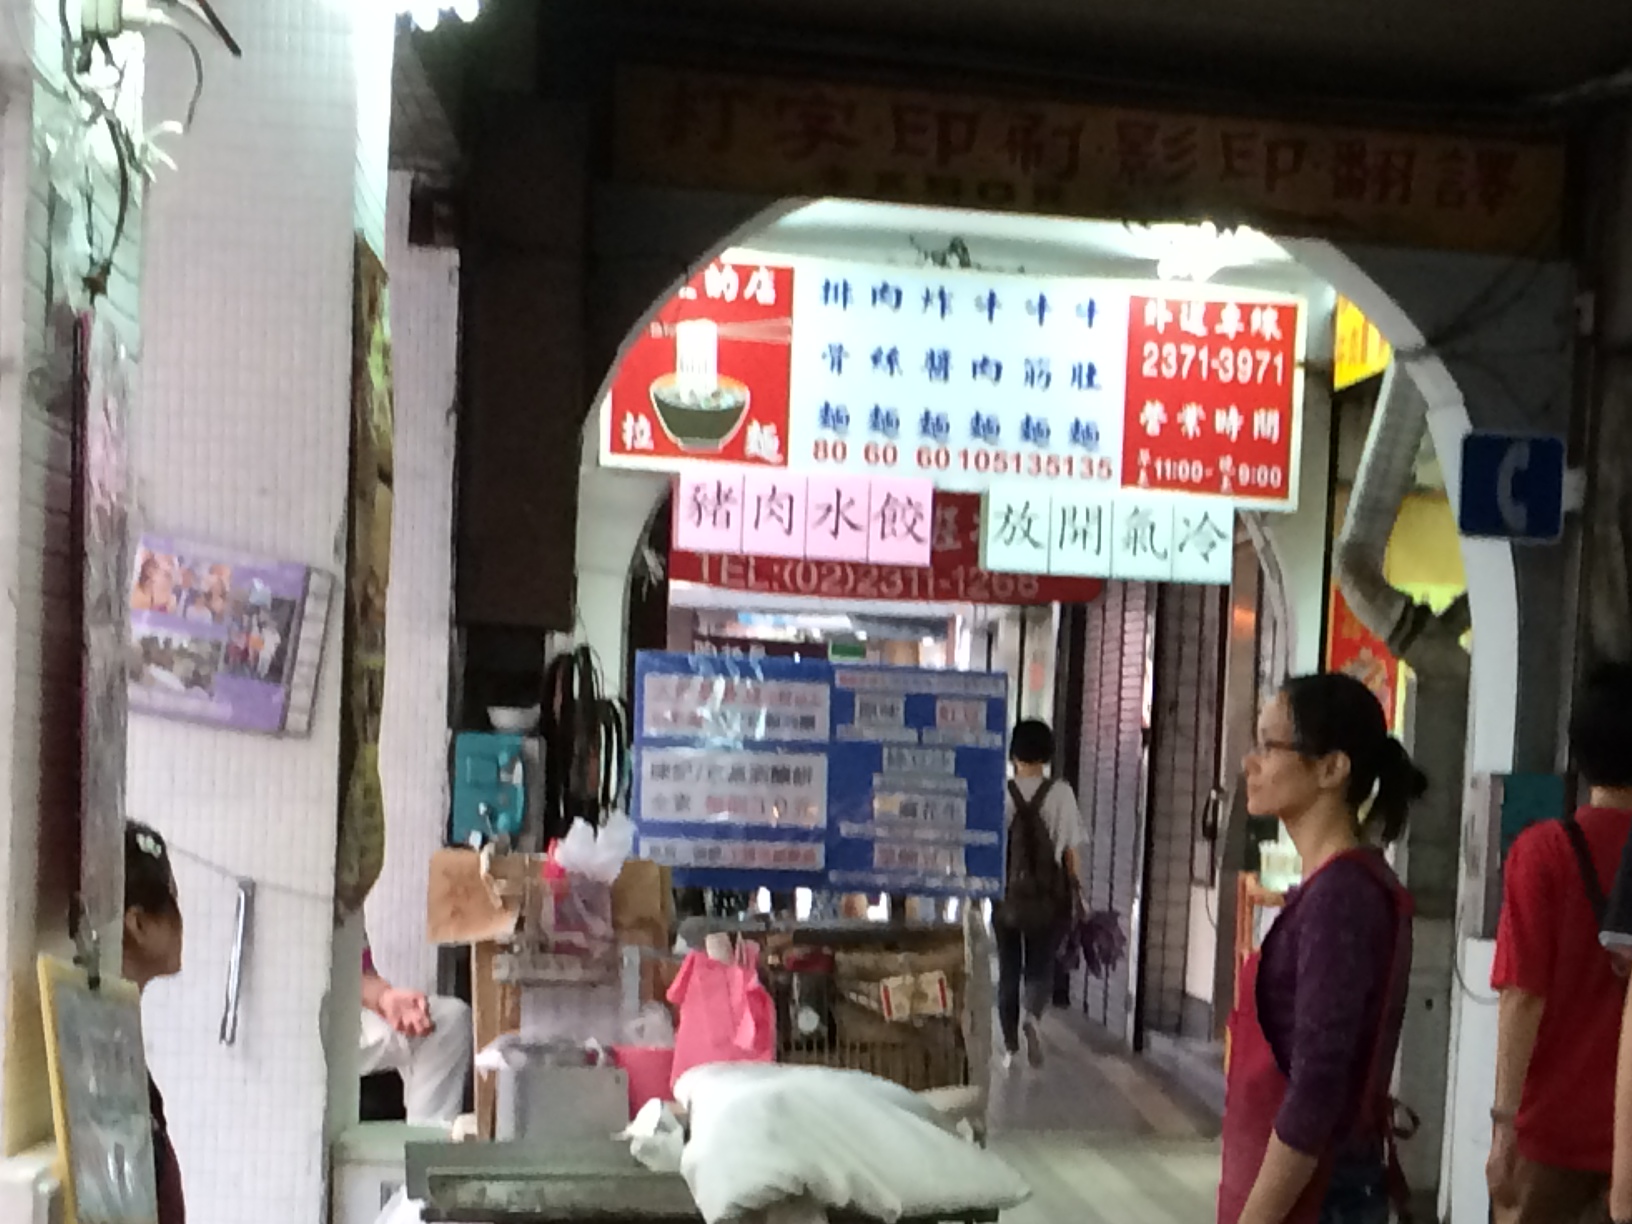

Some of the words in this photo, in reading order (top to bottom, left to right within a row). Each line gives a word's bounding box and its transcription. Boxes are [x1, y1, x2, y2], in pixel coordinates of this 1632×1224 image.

[1142, 342, 1284, 386] 2371-3971
[1140, 399, 1281, 444] 營業時間
[813, 438, 847, 463] 80
[864, 441, 897, 466] 60
[917, 445, 950, 470] 60
[688, 480, 926, 544] 豬肉水餃
